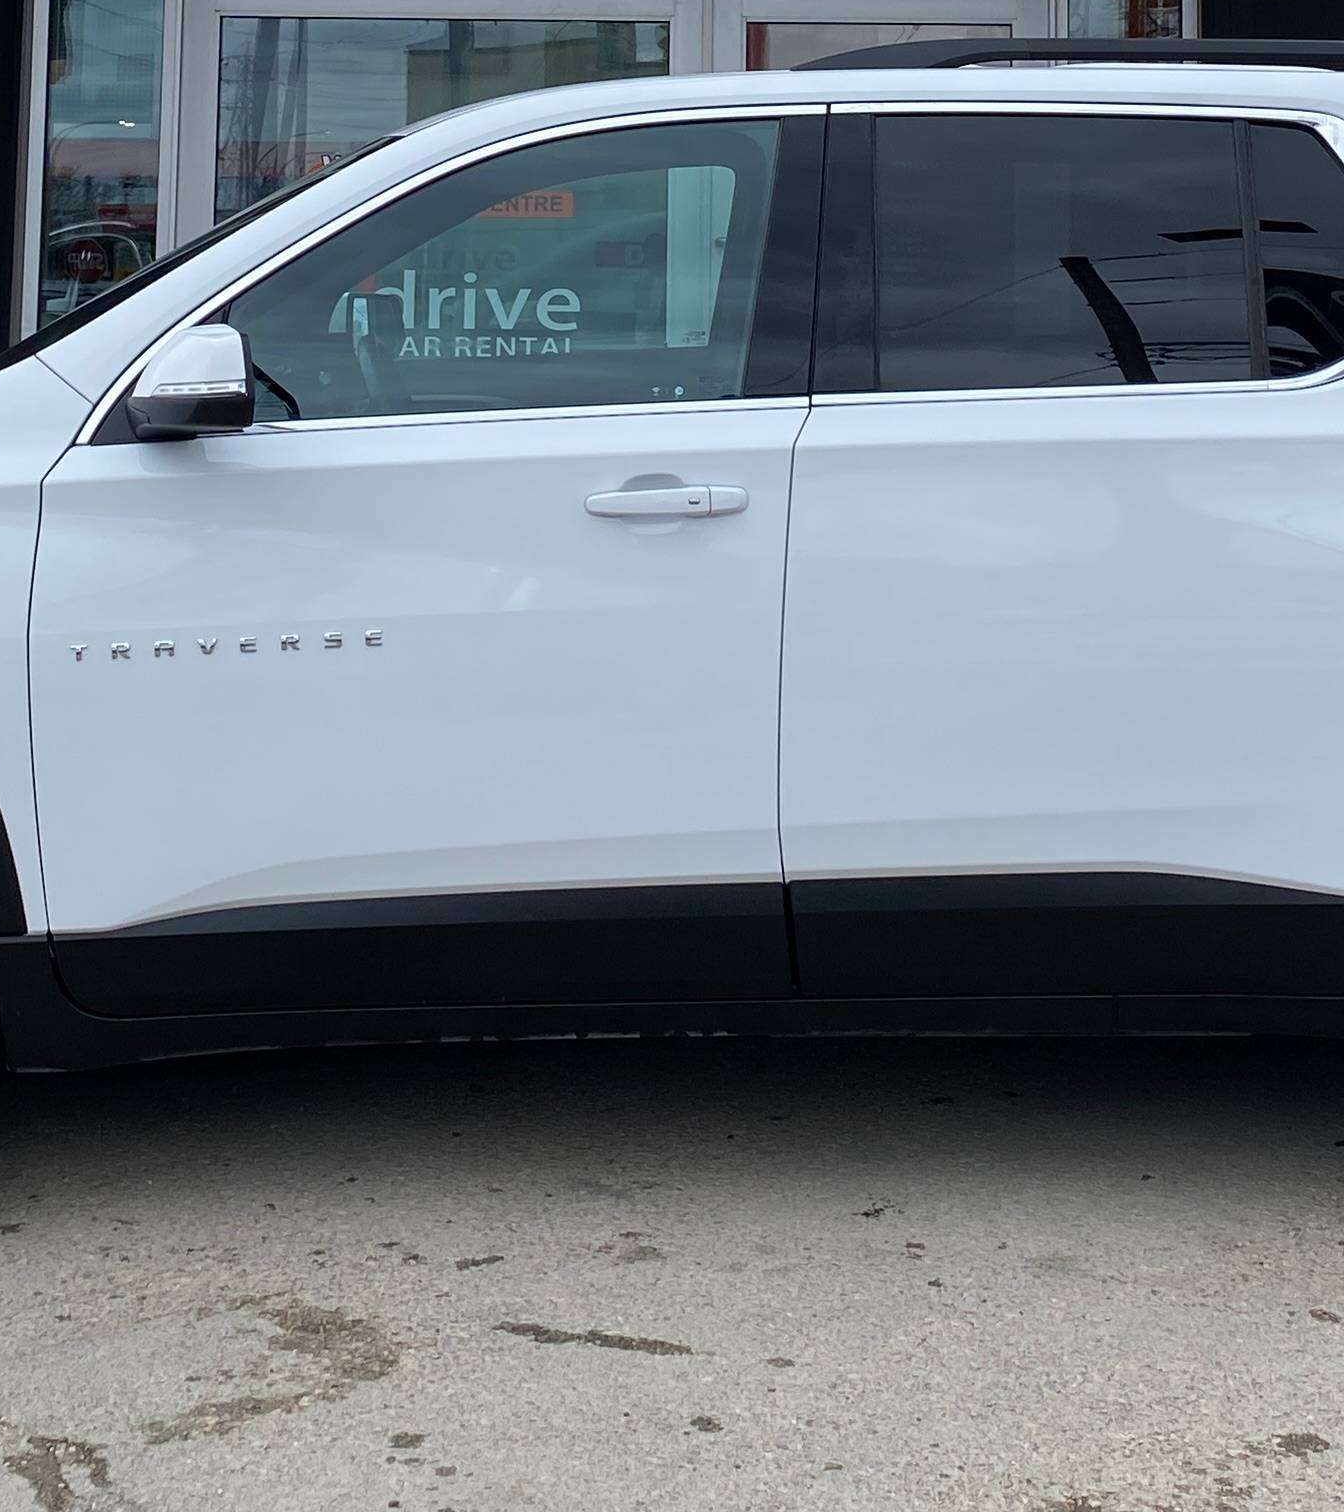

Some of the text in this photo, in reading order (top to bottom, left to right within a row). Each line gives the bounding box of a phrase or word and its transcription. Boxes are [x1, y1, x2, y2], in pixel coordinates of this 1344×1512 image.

[489, 195, 564, 213] ENTRE
[399, 336, 441, 357] AR
[69, 629, 384, 662] TRAVERSE
